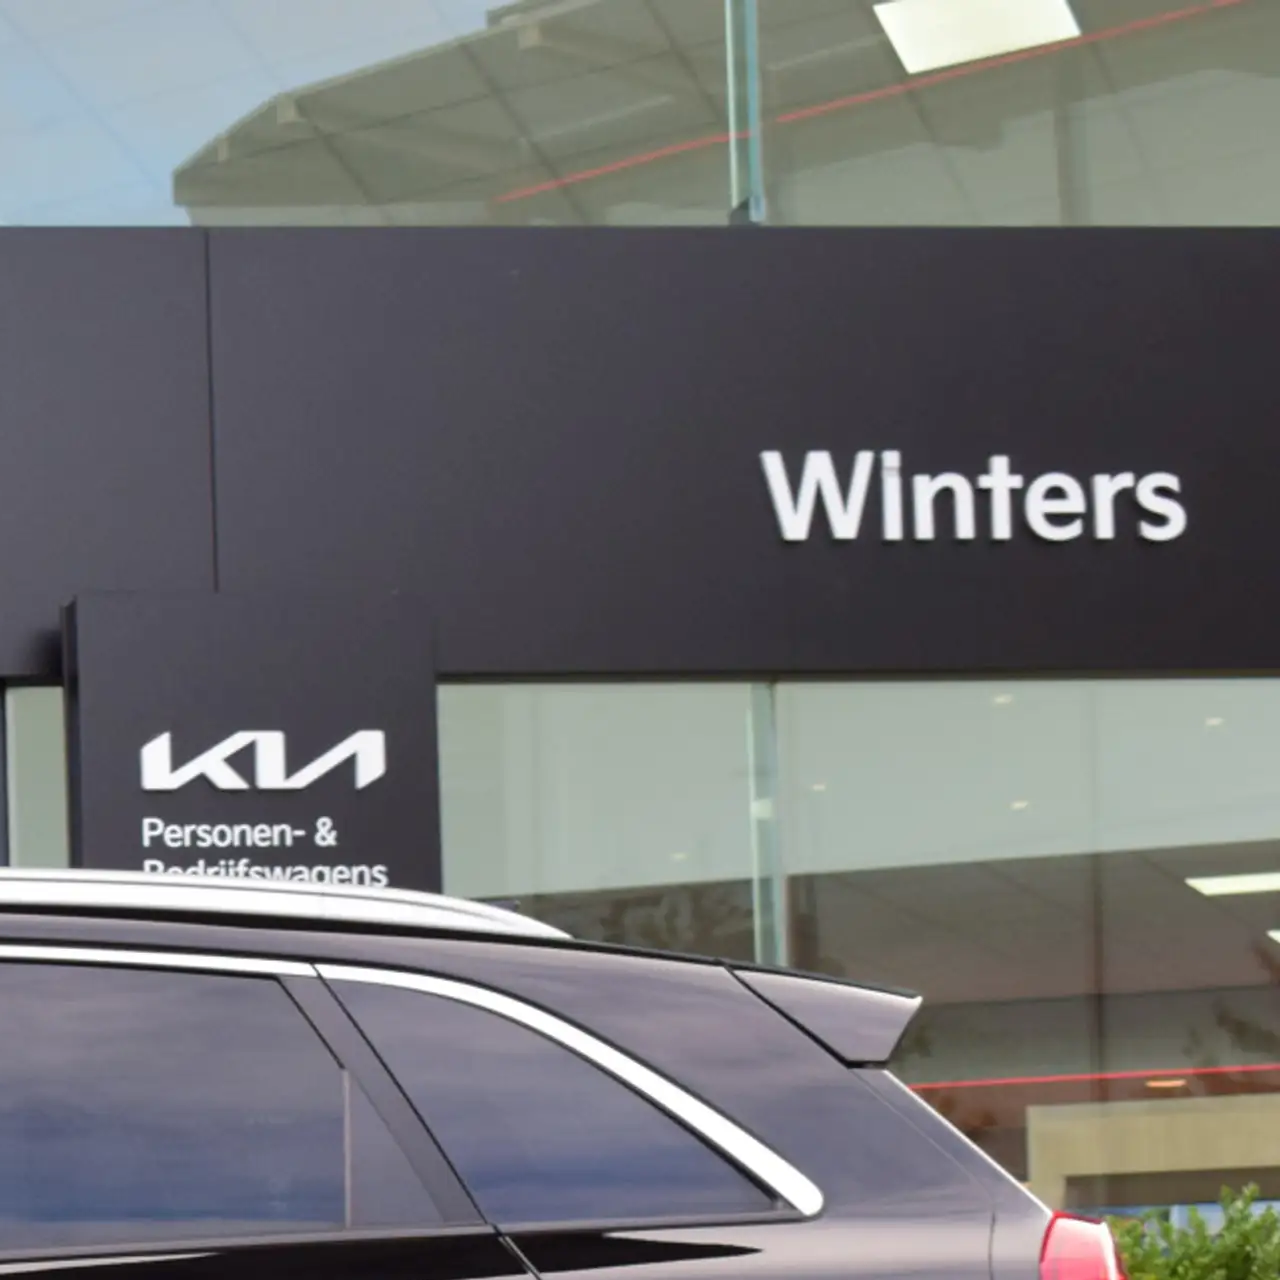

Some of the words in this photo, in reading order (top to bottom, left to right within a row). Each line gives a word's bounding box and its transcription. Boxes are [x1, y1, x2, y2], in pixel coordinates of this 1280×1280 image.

[760, 450, 1188, 541] Winters
[140, 729, 387, 791] KIA
[142, 817, 306, 849] Personen-
[313, 815, 338, 848] &
